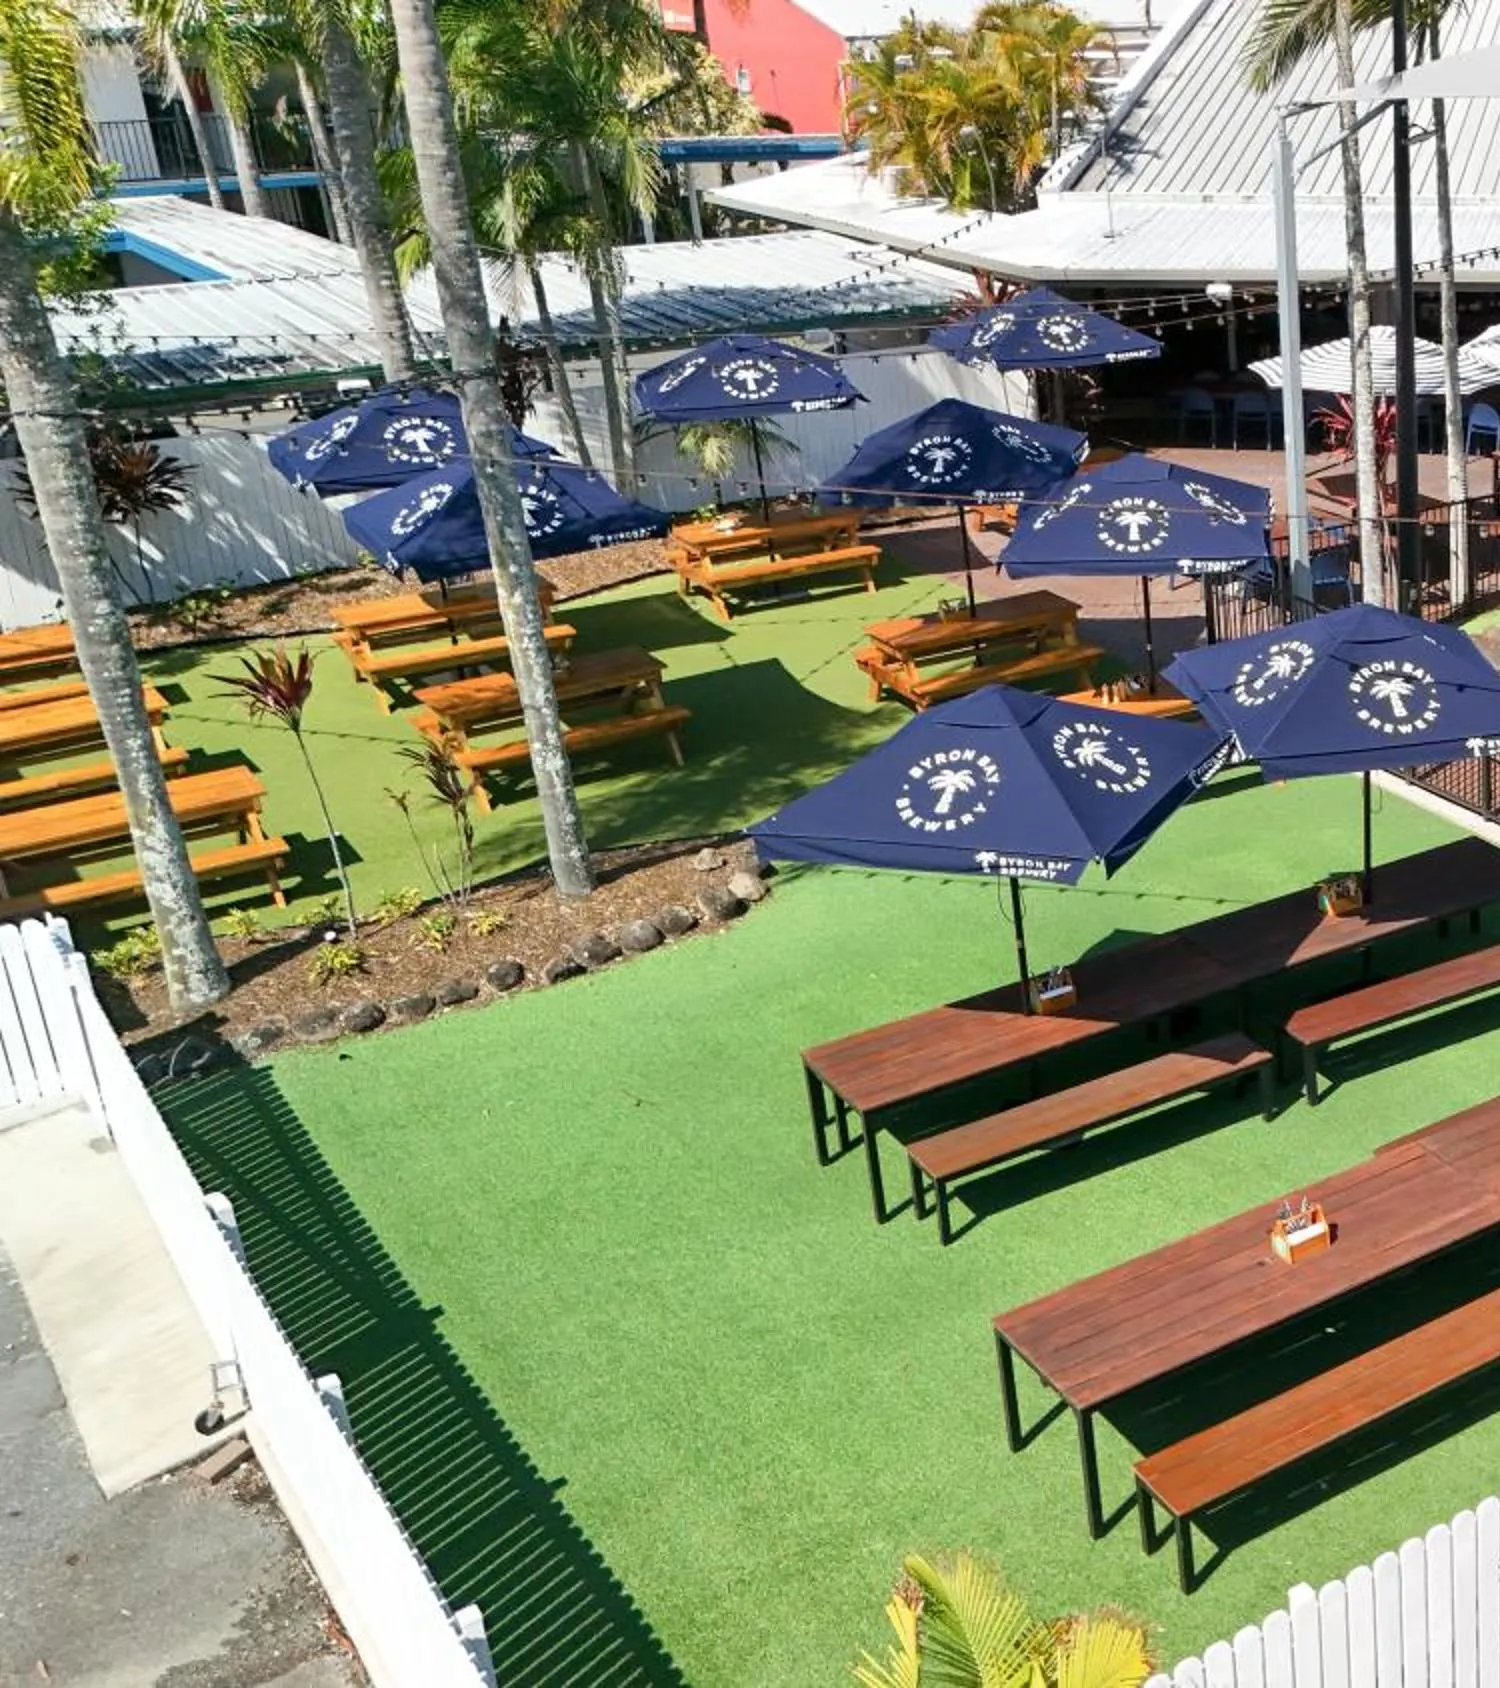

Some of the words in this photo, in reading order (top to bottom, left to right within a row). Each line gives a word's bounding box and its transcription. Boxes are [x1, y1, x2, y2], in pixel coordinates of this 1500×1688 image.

[1349, 660, 1396, 694] BYRON
[1401, 661, 1436, 685] BAY
[1073, 722, 1112, 737] BAY
[1356, 699, 1442, 735] BREWERY
[908, 749, 977, 780] BYRON
[977, 755, 1001, 784] BAY
[895, 797, 987, 833] BREWERY
